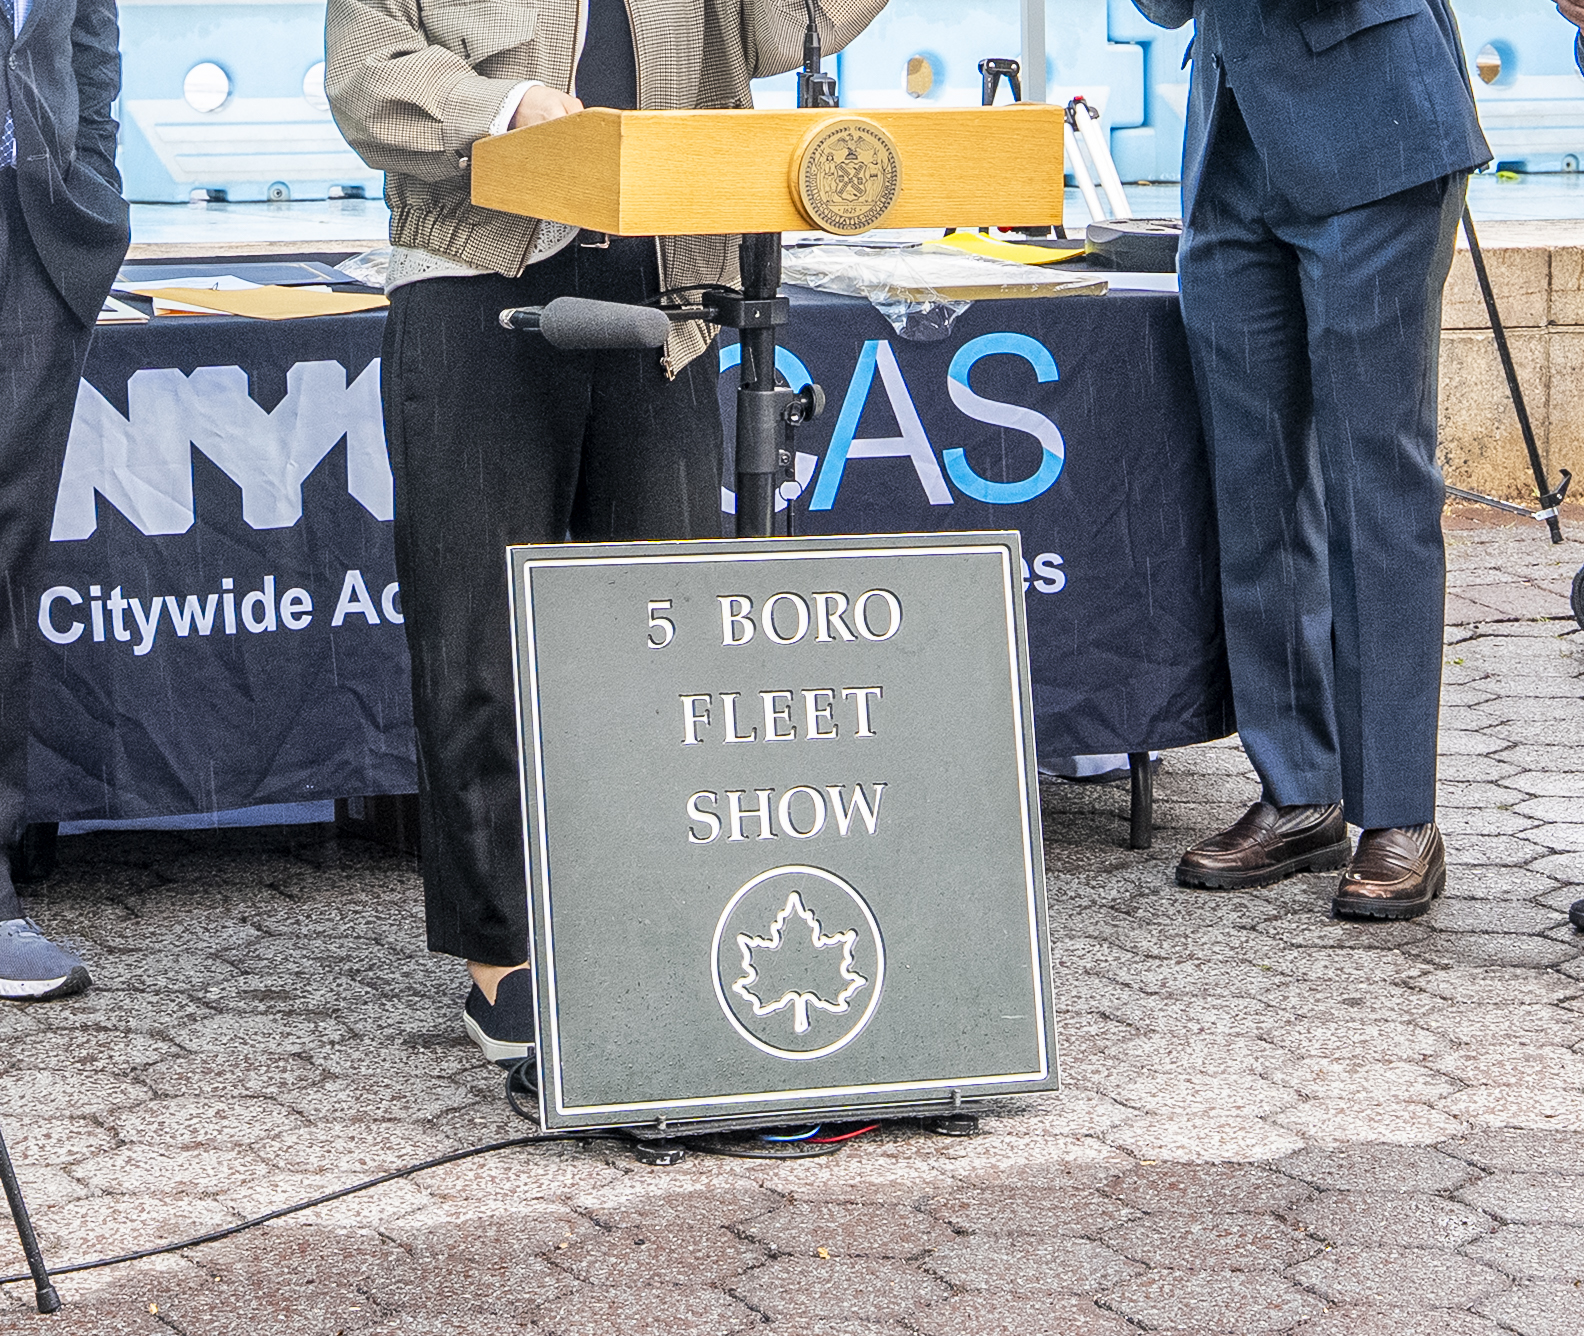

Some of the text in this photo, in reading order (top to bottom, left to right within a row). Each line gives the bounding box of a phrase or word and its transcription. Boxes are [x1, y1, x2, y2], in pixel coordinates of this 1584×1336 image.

[38, 575, 313, 656] Citywide
[646, 587, 904, 650] 5 BORO
[678, 684, 885, 747] FLEET
[686, 781, 888, 846] SHOW
